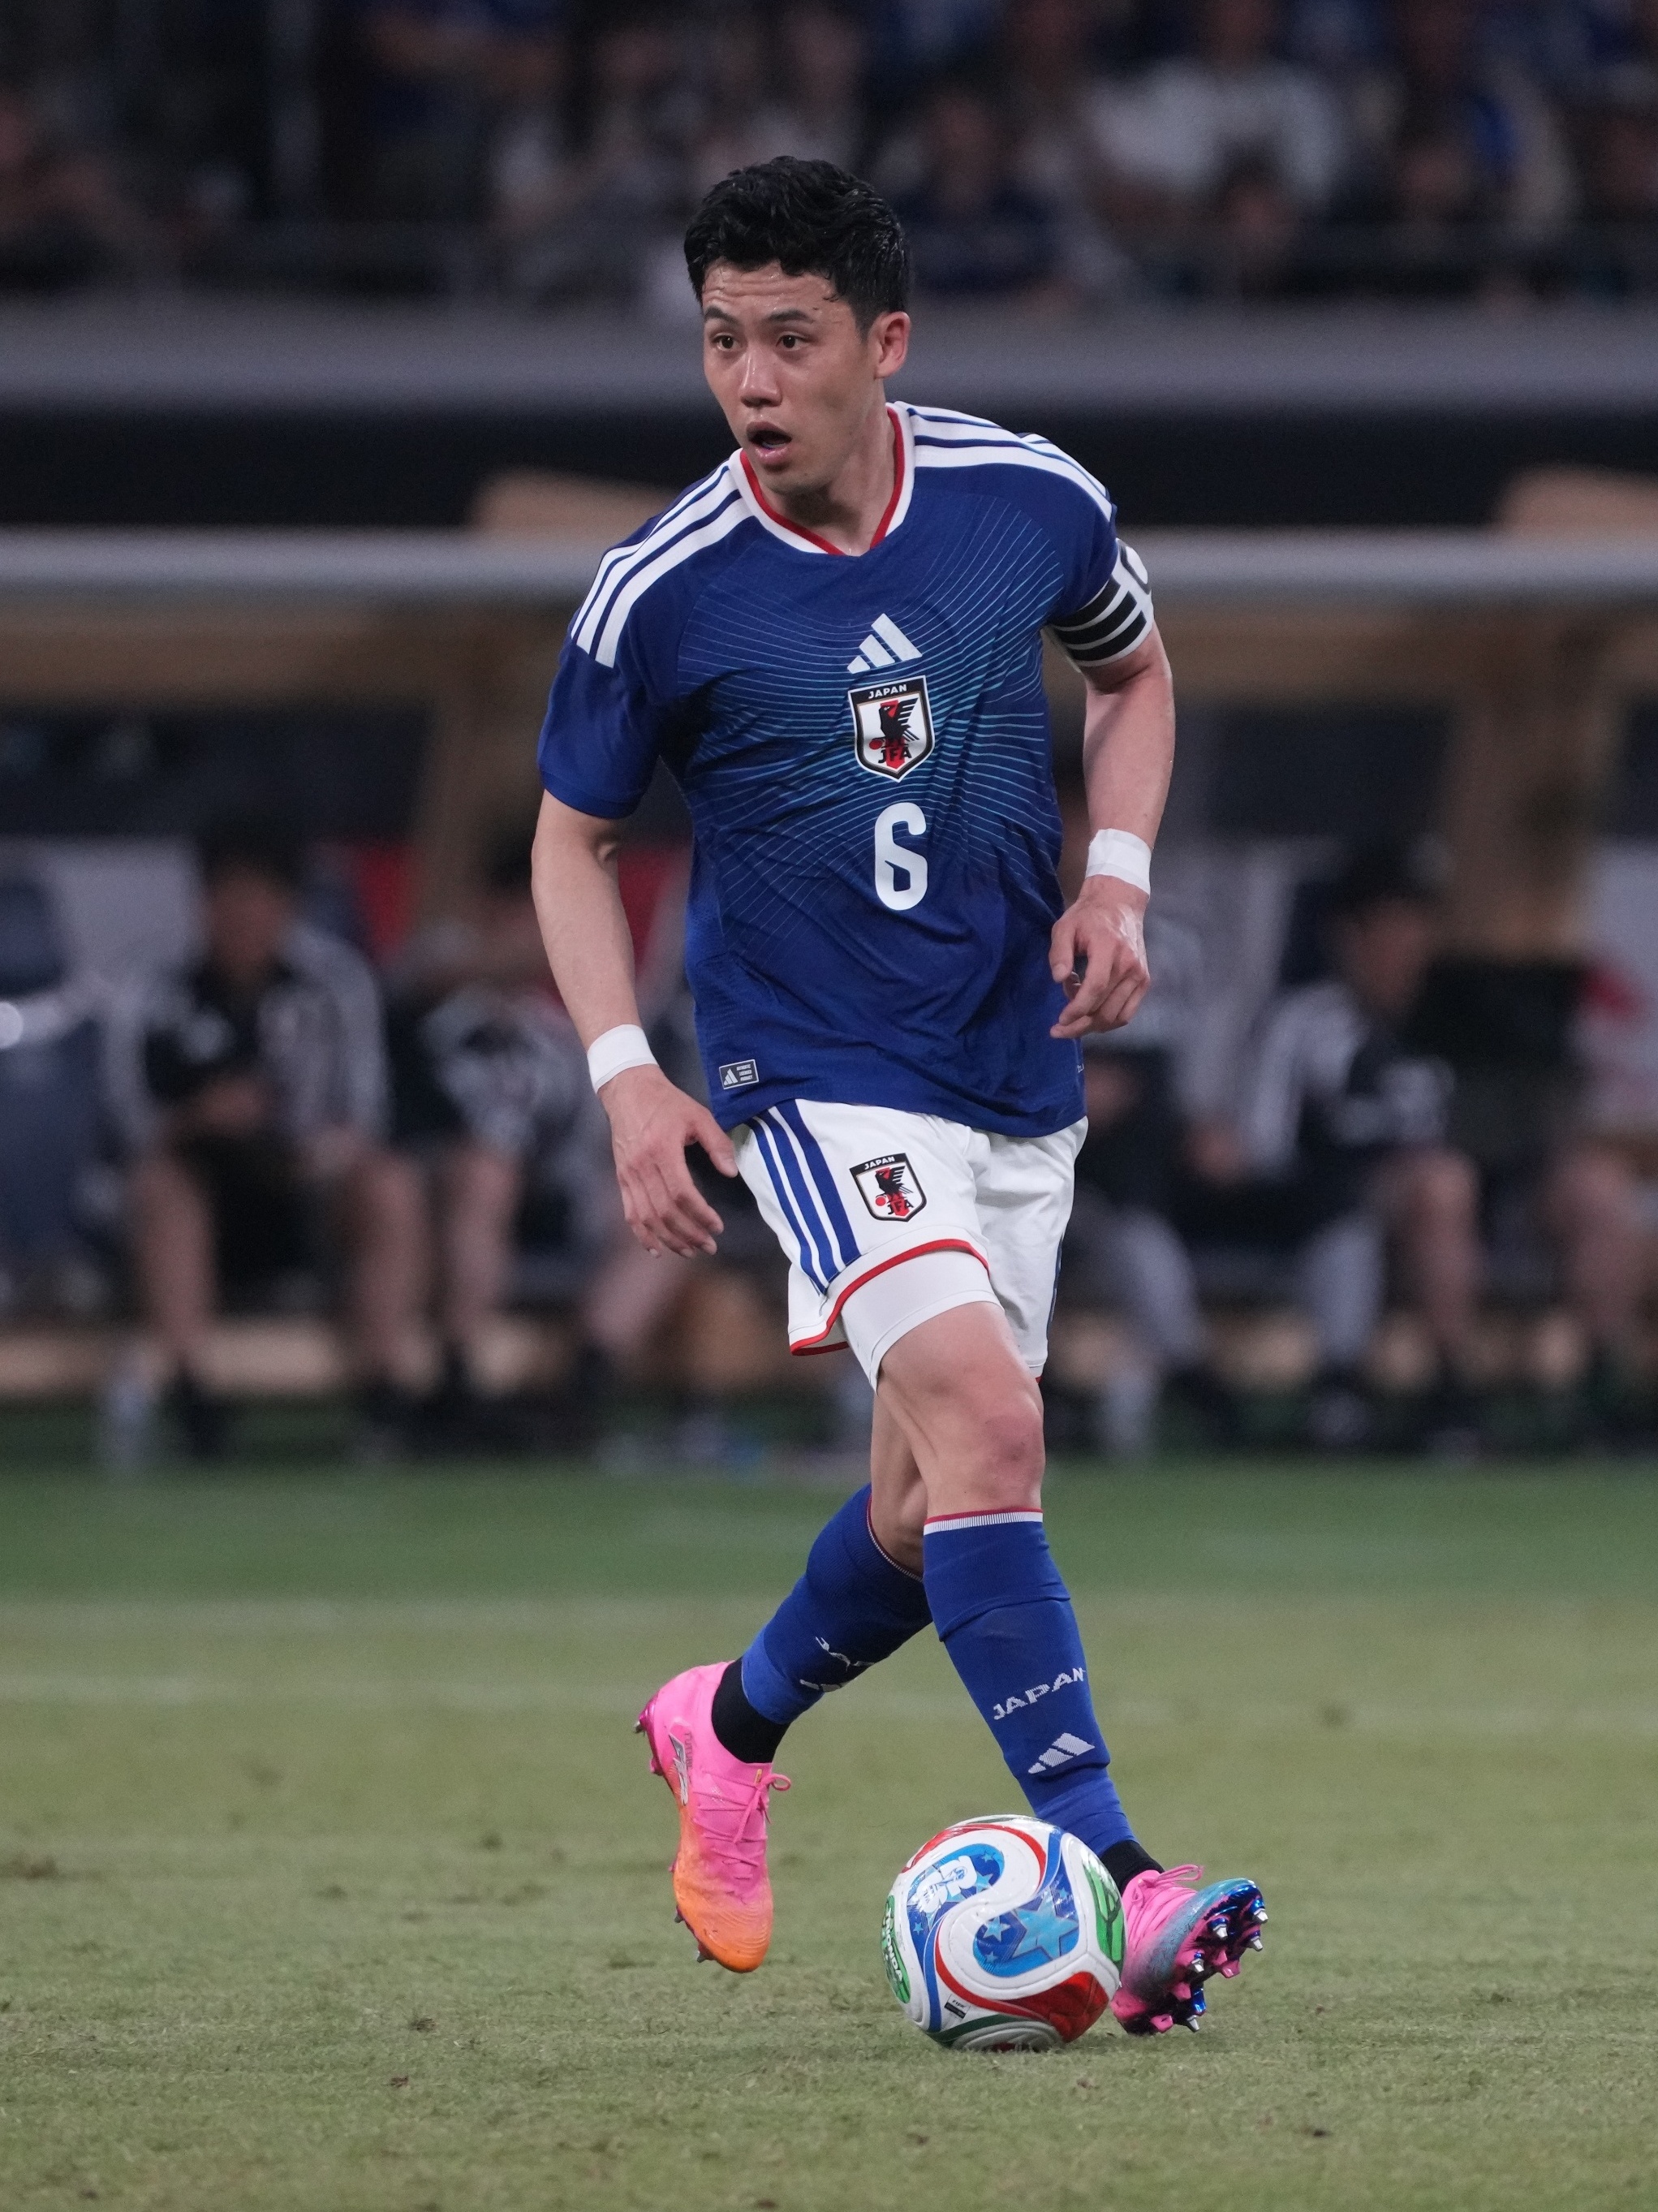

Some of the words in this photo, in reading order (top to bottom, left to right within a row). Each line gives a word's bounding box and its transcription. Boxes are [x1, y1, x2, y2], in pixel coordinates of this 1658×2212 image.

[868, 683, 907, 699] JAPAN
[878, 745, 912, 764] JFA
[875, 802, 928, 911] 6
[864, 1156, 895, 1170] JAPAN
[887, 1199, 914, 1215] JFA
[993, 1667, 1085, 1720] JAPAN
[885, 1906, 903, 1982] TRIONDA
